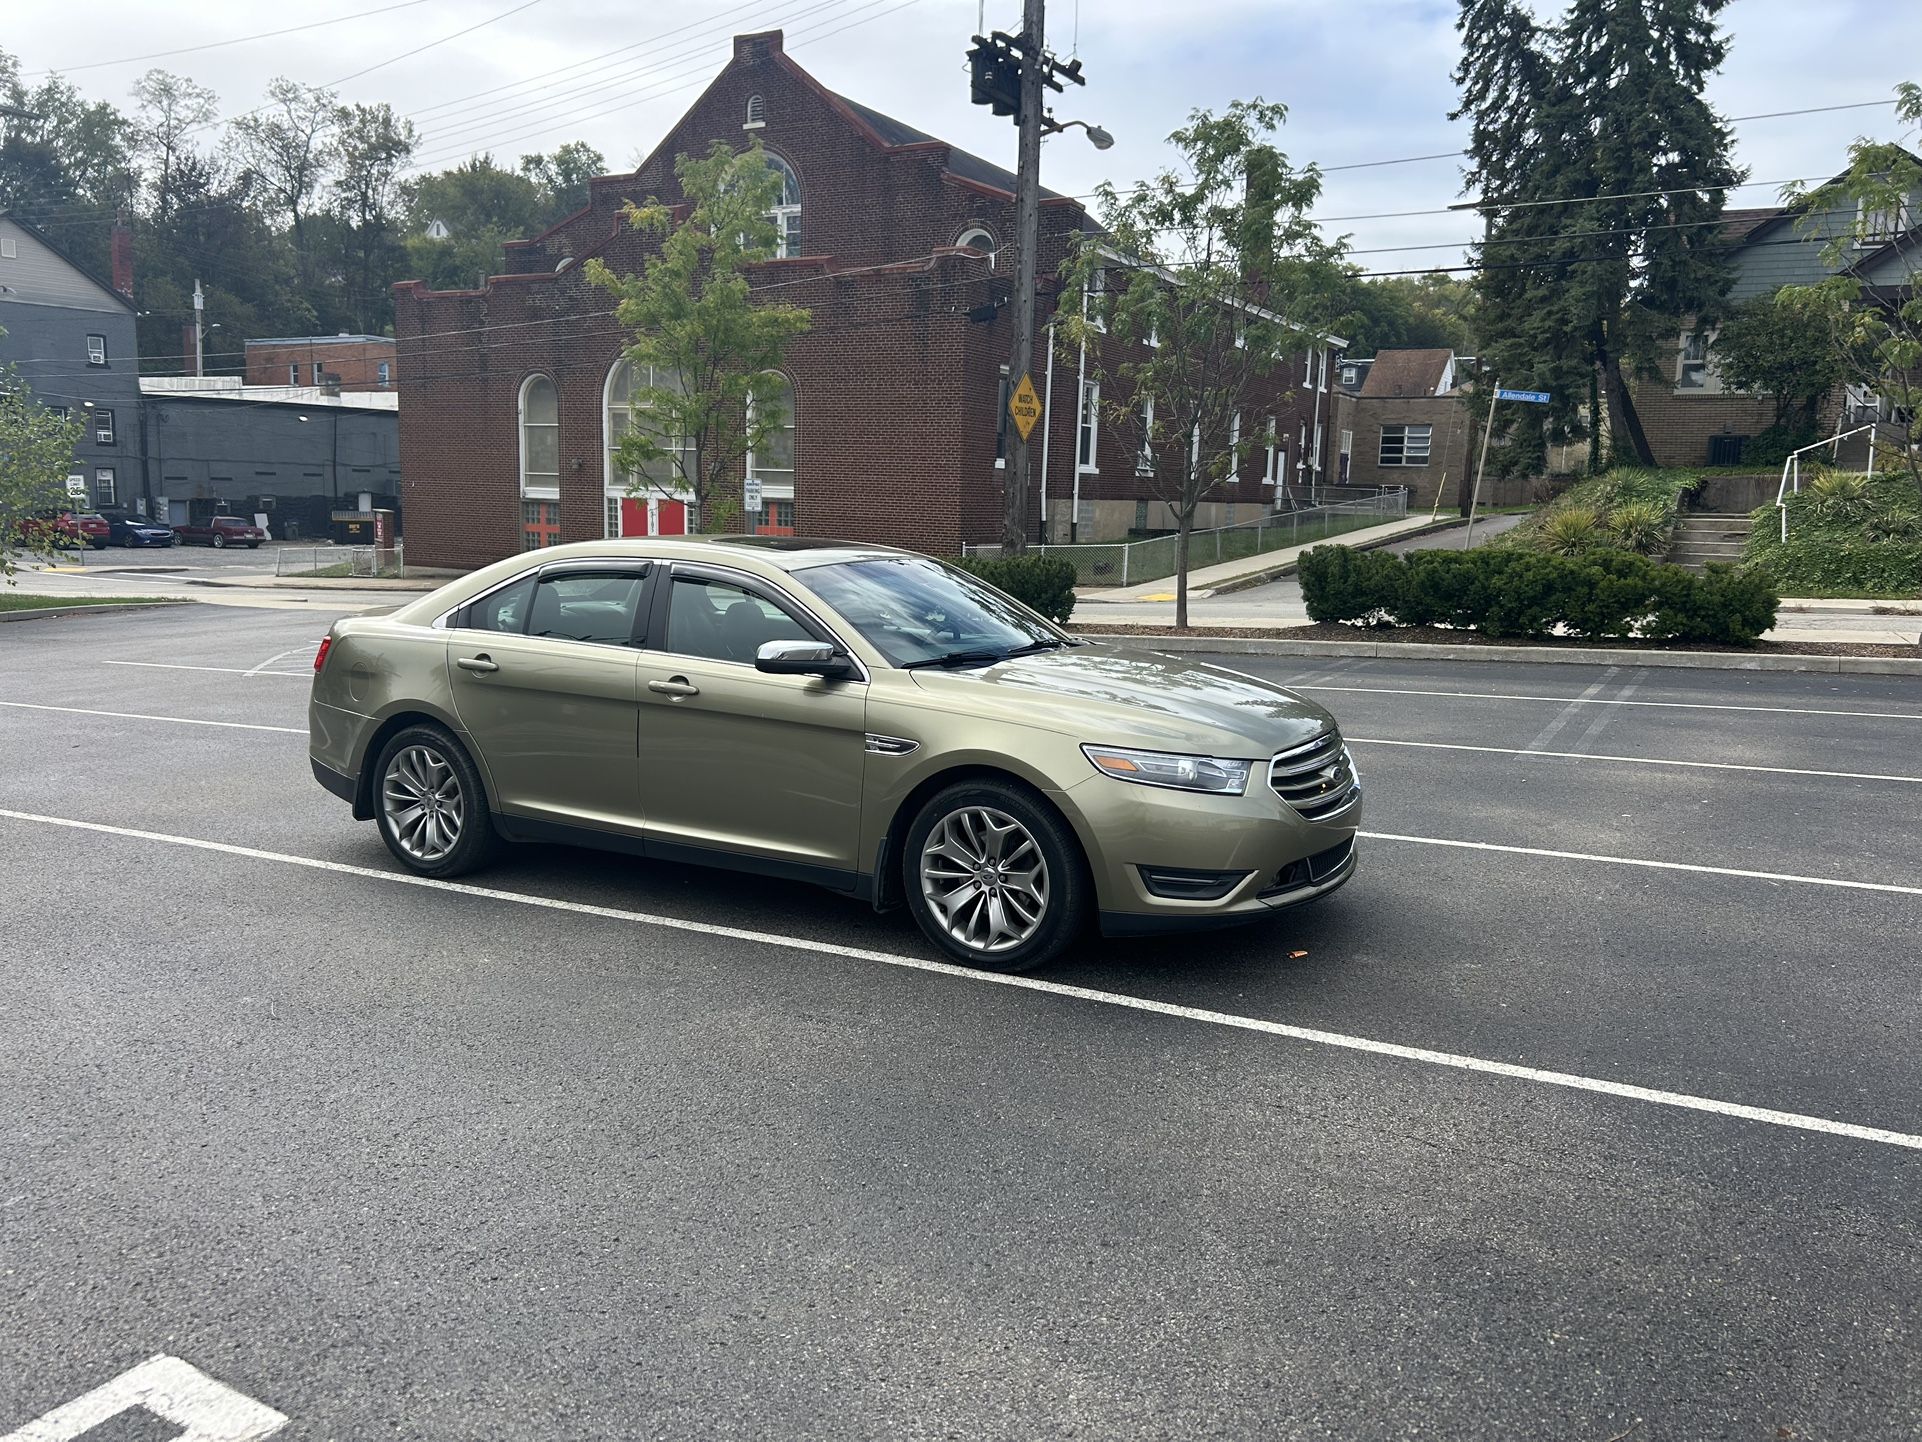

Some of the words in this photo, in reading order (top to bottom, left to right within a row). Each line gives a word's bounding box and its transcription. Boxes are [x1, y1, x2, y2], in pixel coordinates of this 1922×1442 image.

[1018, 393, 1033, 404] WATCH
[1501, 391, 1536, 401] Allendale
[1538, 394, 1547, 402] St
[1015, 406, 1037, 418] CHILDREN
